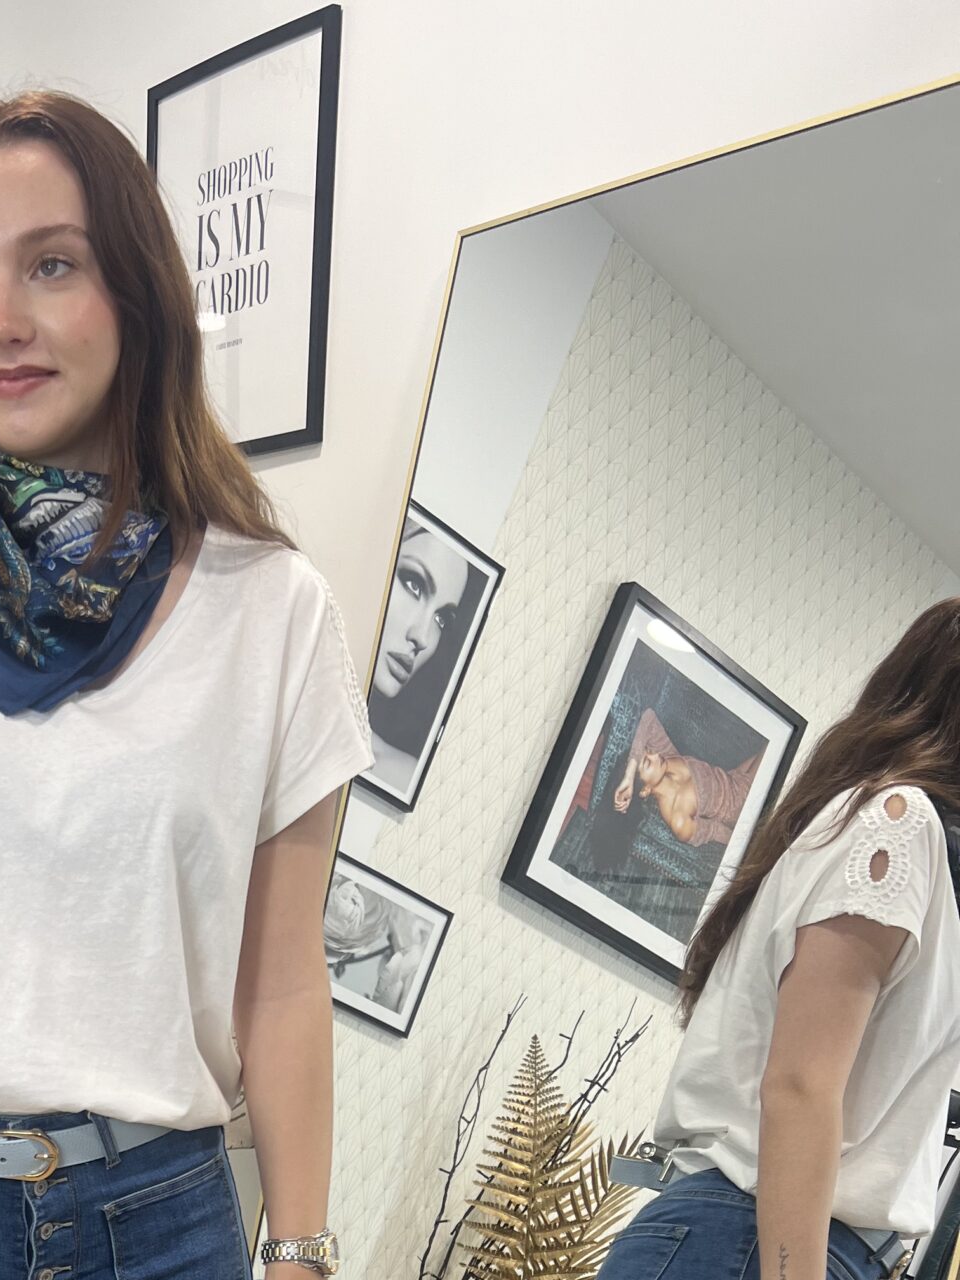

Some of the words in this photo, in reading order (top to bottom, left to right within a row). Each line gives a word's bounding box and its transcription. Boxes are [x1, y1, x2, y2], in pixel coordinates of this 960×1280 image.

[197, 146, 274, 206] SHOPPING
[196, 209, 221, 272] IS
[229, 189, 274, 261] MY
[196, 260, 270, 315] CARDIO
